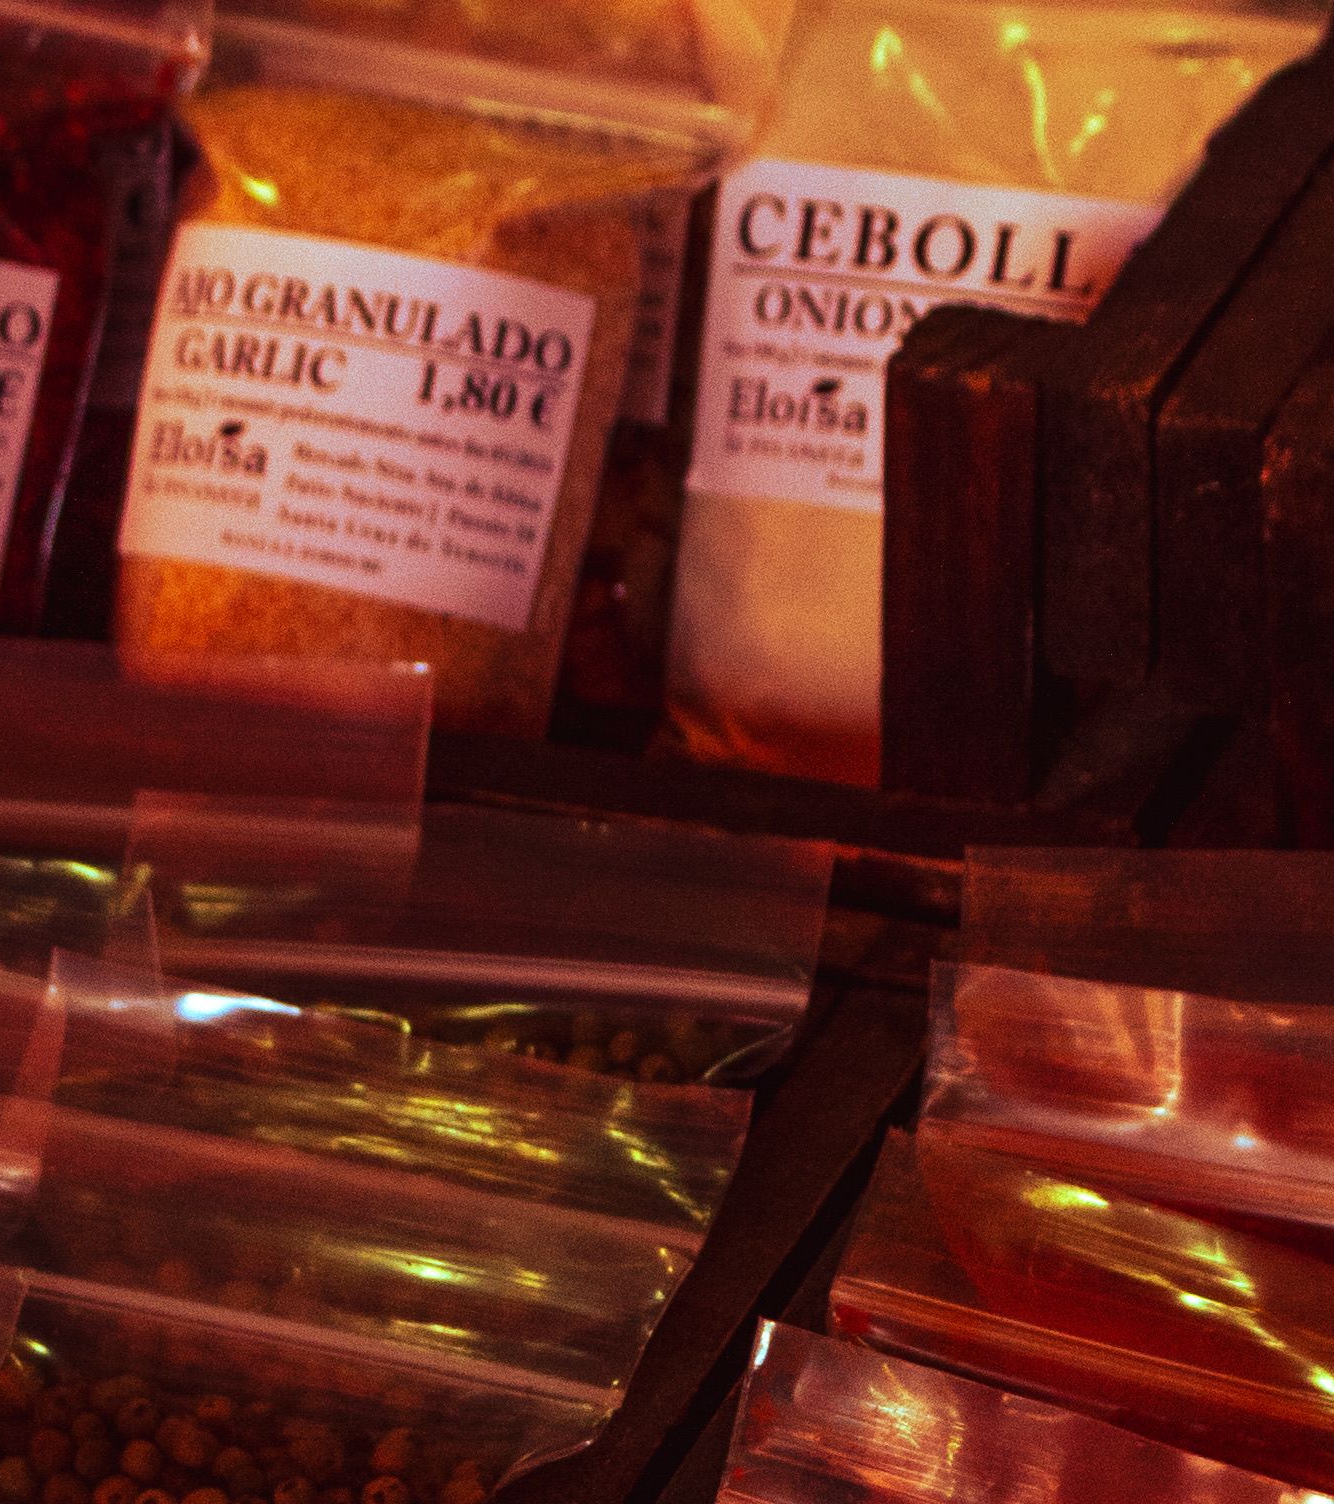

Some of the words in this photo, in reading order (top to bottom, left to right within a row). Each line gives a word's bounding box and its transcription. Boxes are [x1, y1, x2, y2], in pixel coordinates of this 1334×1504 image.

[735, 194, 1092, 296] CEBOLL
[174, 325, 349, 395] GARLIC
[417, 359, 519, 422] 1,80
[242, 273, 575, 375] GRANULADO
